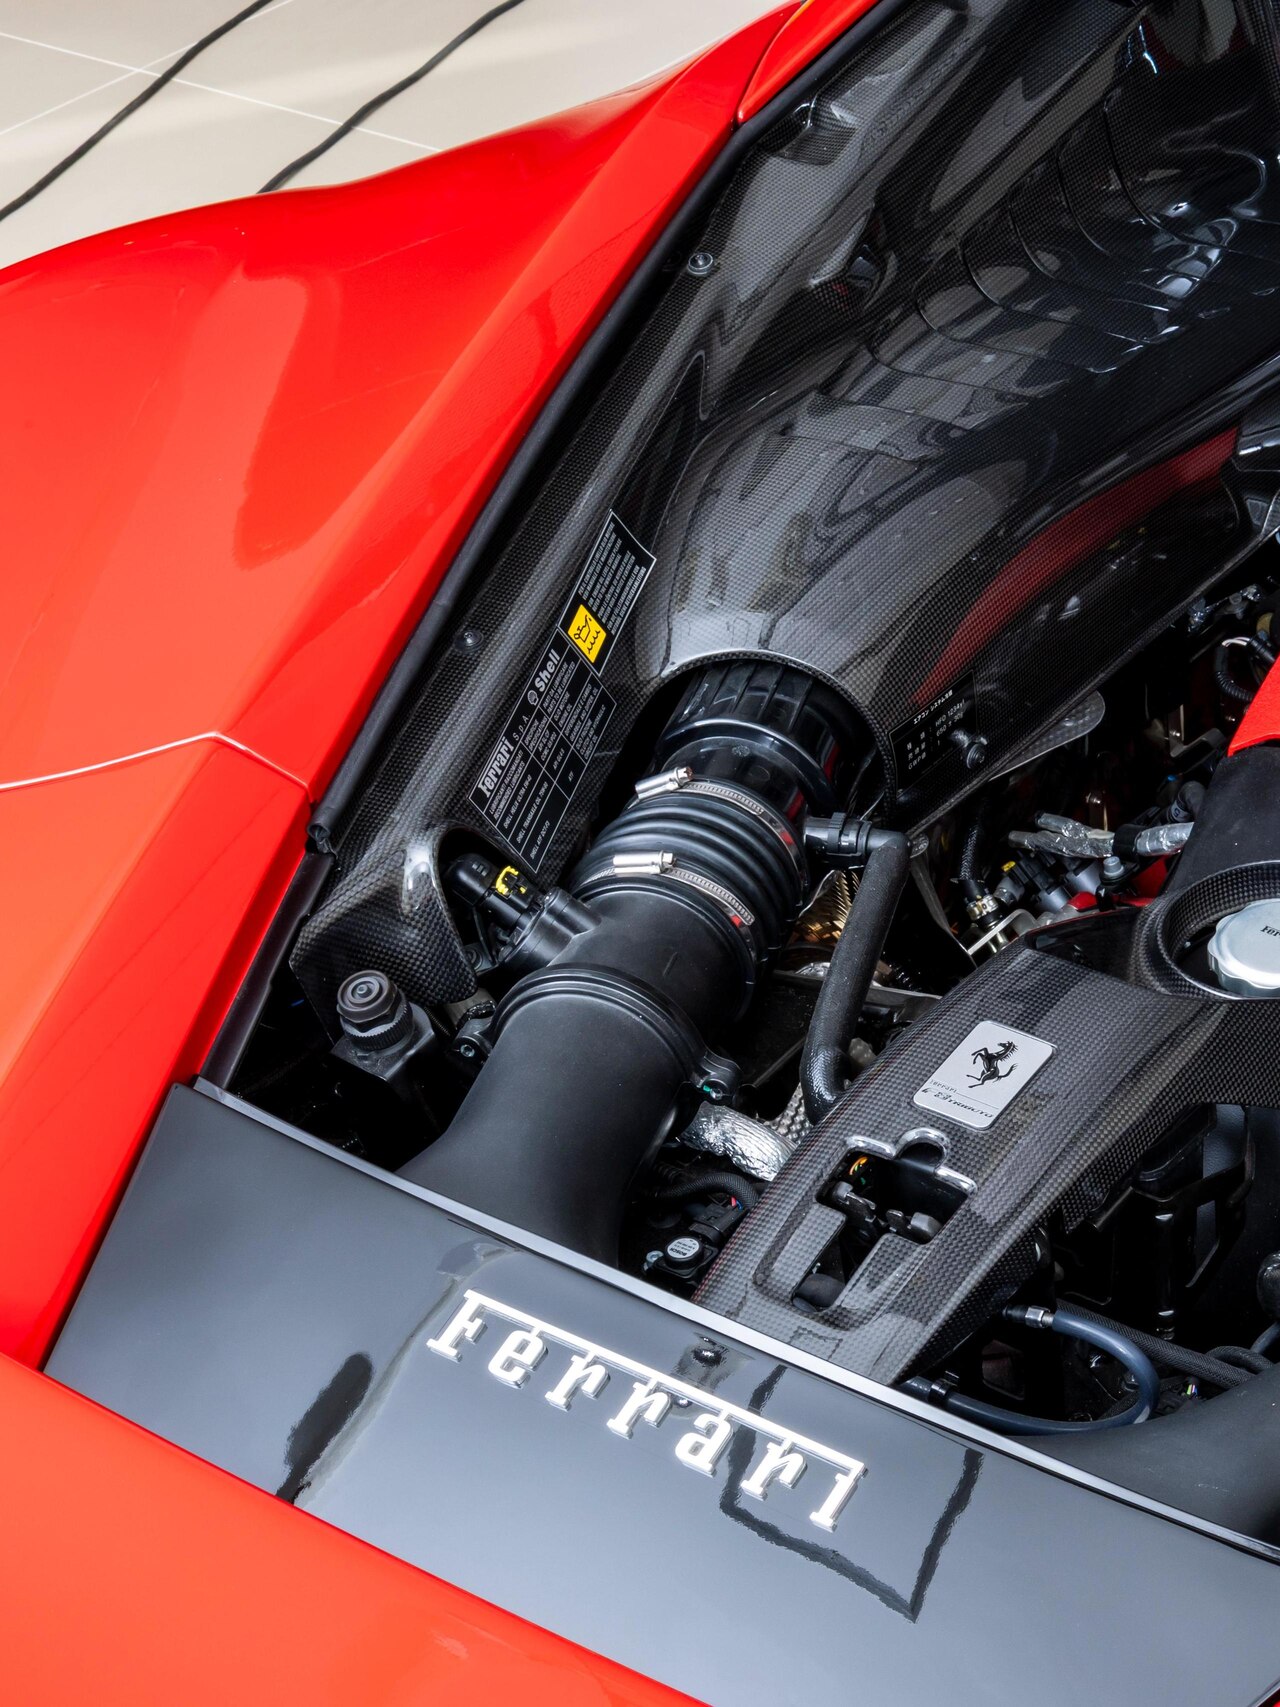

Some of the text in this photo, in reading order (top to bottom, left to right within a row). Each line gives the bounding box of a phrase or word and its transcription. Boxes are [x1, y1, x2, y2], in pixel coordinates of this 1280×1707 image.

[477, 737, 514, 798] Ferrari
[535, 649, 560, 693] Shell
[504, 814, 512, 828] SHELL
[517, 828, 525, 843] SHELL
[530, 844, 539, 859] SHELL
[426, 1288, 868, 1533] Ferrari
